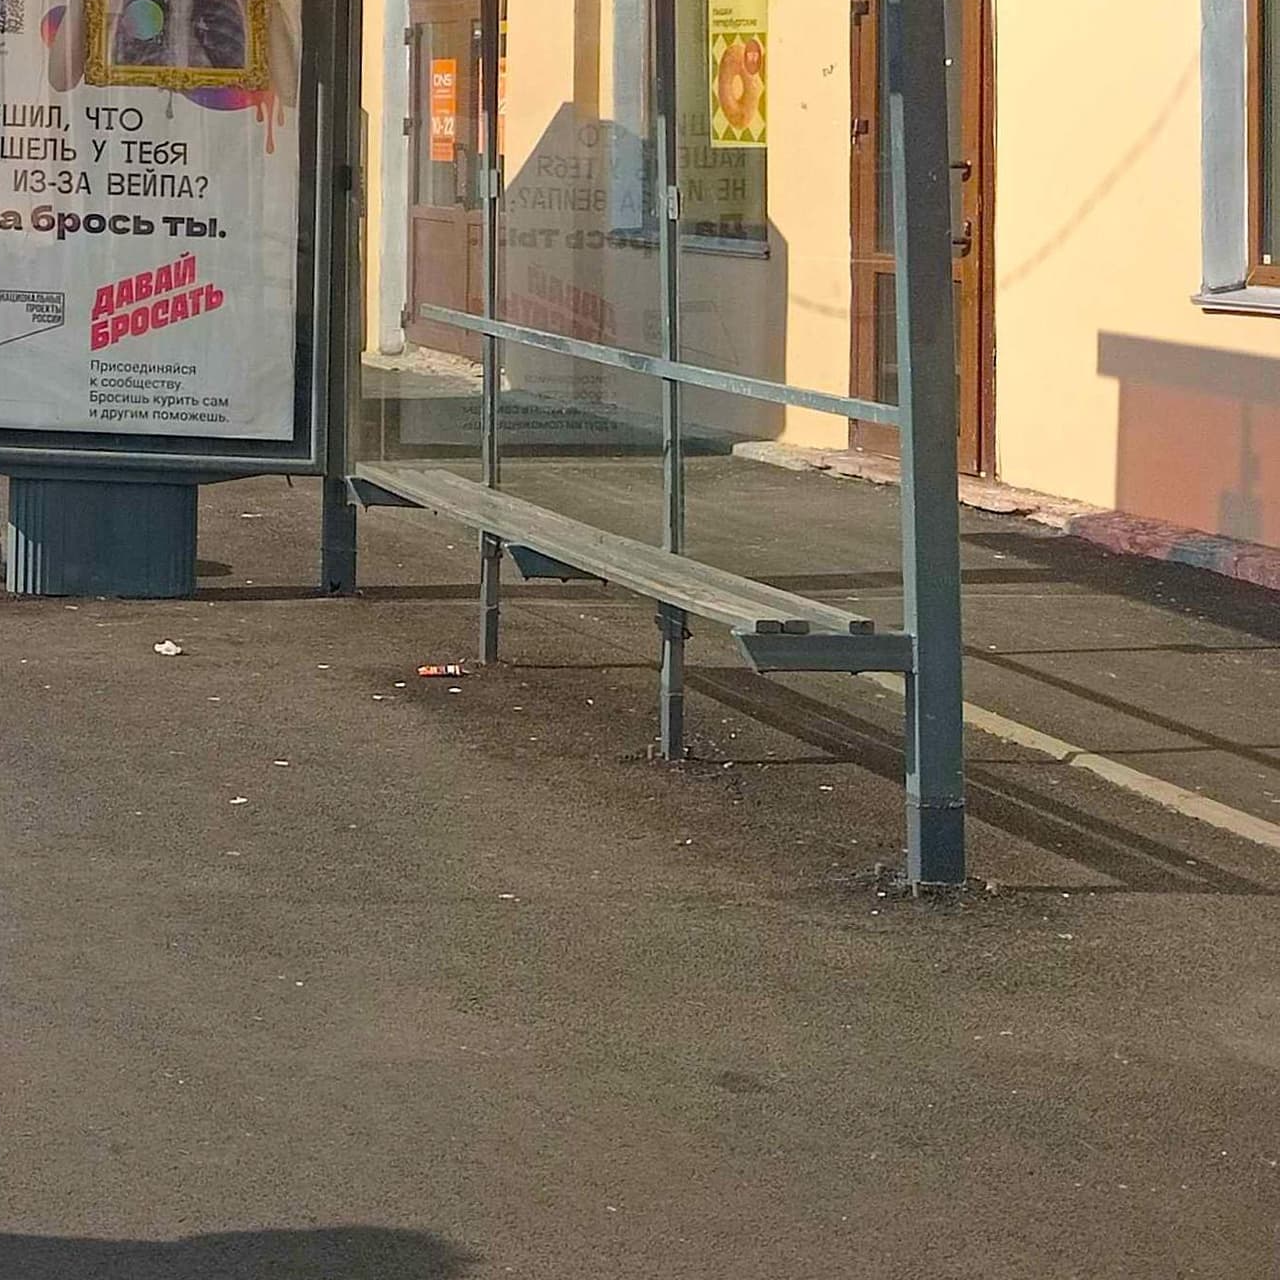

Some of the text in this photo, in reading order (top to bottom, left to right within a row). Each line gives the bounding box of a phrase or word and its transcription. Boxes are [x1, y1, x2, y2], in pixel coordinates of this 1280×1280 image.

[433, 73, 453, 87] DNS
[85, 107, 143, 132] ЧТО
[92, 139, 107, 163] У
[13, 170, 92, 195] ИЗ-ЗА
[107, 168, 209, 198] ВЕЙПА?
[31, 204, 154, 240] брось
[162, 215, 227, 239] ты.
[91, 251, 197, 321] ДАВАЙ
[0, 293, 62, 304] НАЦИОНАЛЬНЫЕ
[26, 304, 62, 313] ПРОЕКТЫ
[90, 283, 224, 351] БРОСАТЬ
[90, 360, 197, 376] Присоединяйся
[90, 378, 97, 387] к
[89, 391, 229, 408] Бросишь курить сам
[89, 408, 230, 423] и другим поможешь.
